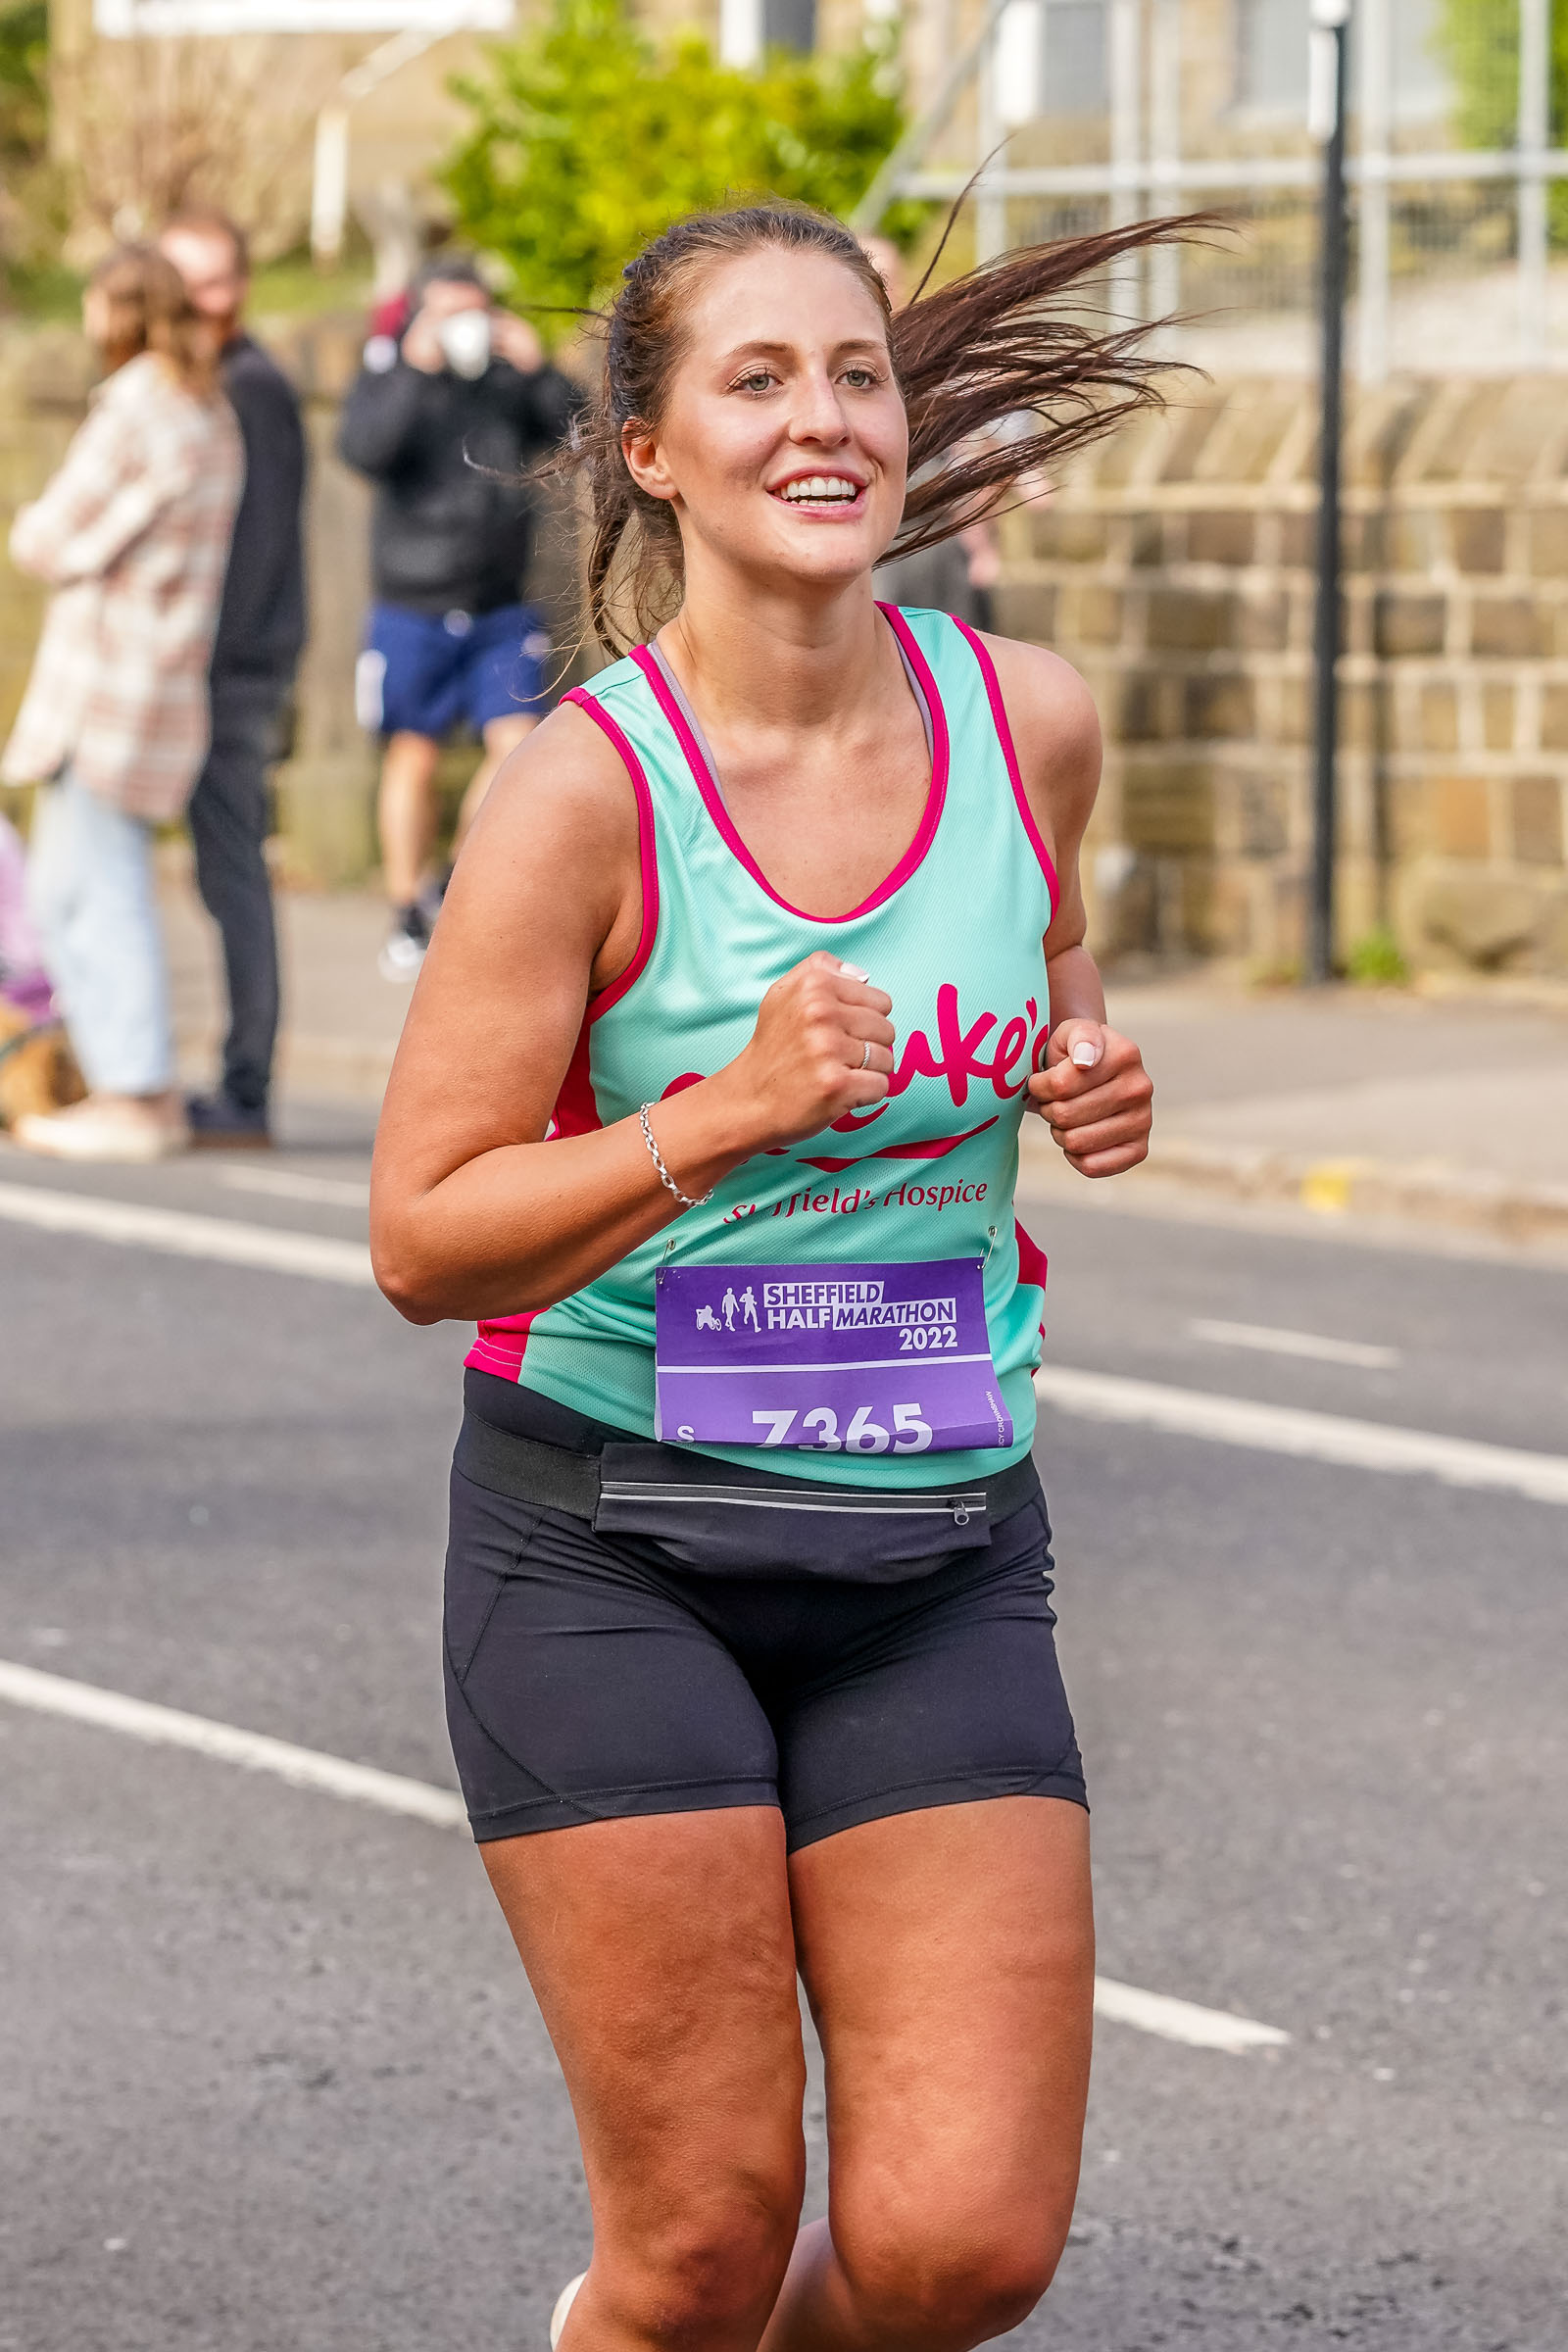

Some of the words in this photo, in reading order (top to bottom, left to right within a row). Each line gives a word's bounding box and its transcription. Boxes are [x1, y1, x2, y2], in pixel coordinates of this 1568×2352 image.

[883, 1178, 988, 1211] Hospice
[766, 1284, 882, 1305] SHEFFIELD
[767, 1308, 831, 1330] HALF
[835, 1300, 954, 1327] MARATHON
[899, 1325, 958, 1351] 2022
[752, 1402, 933, 1454] 7365
